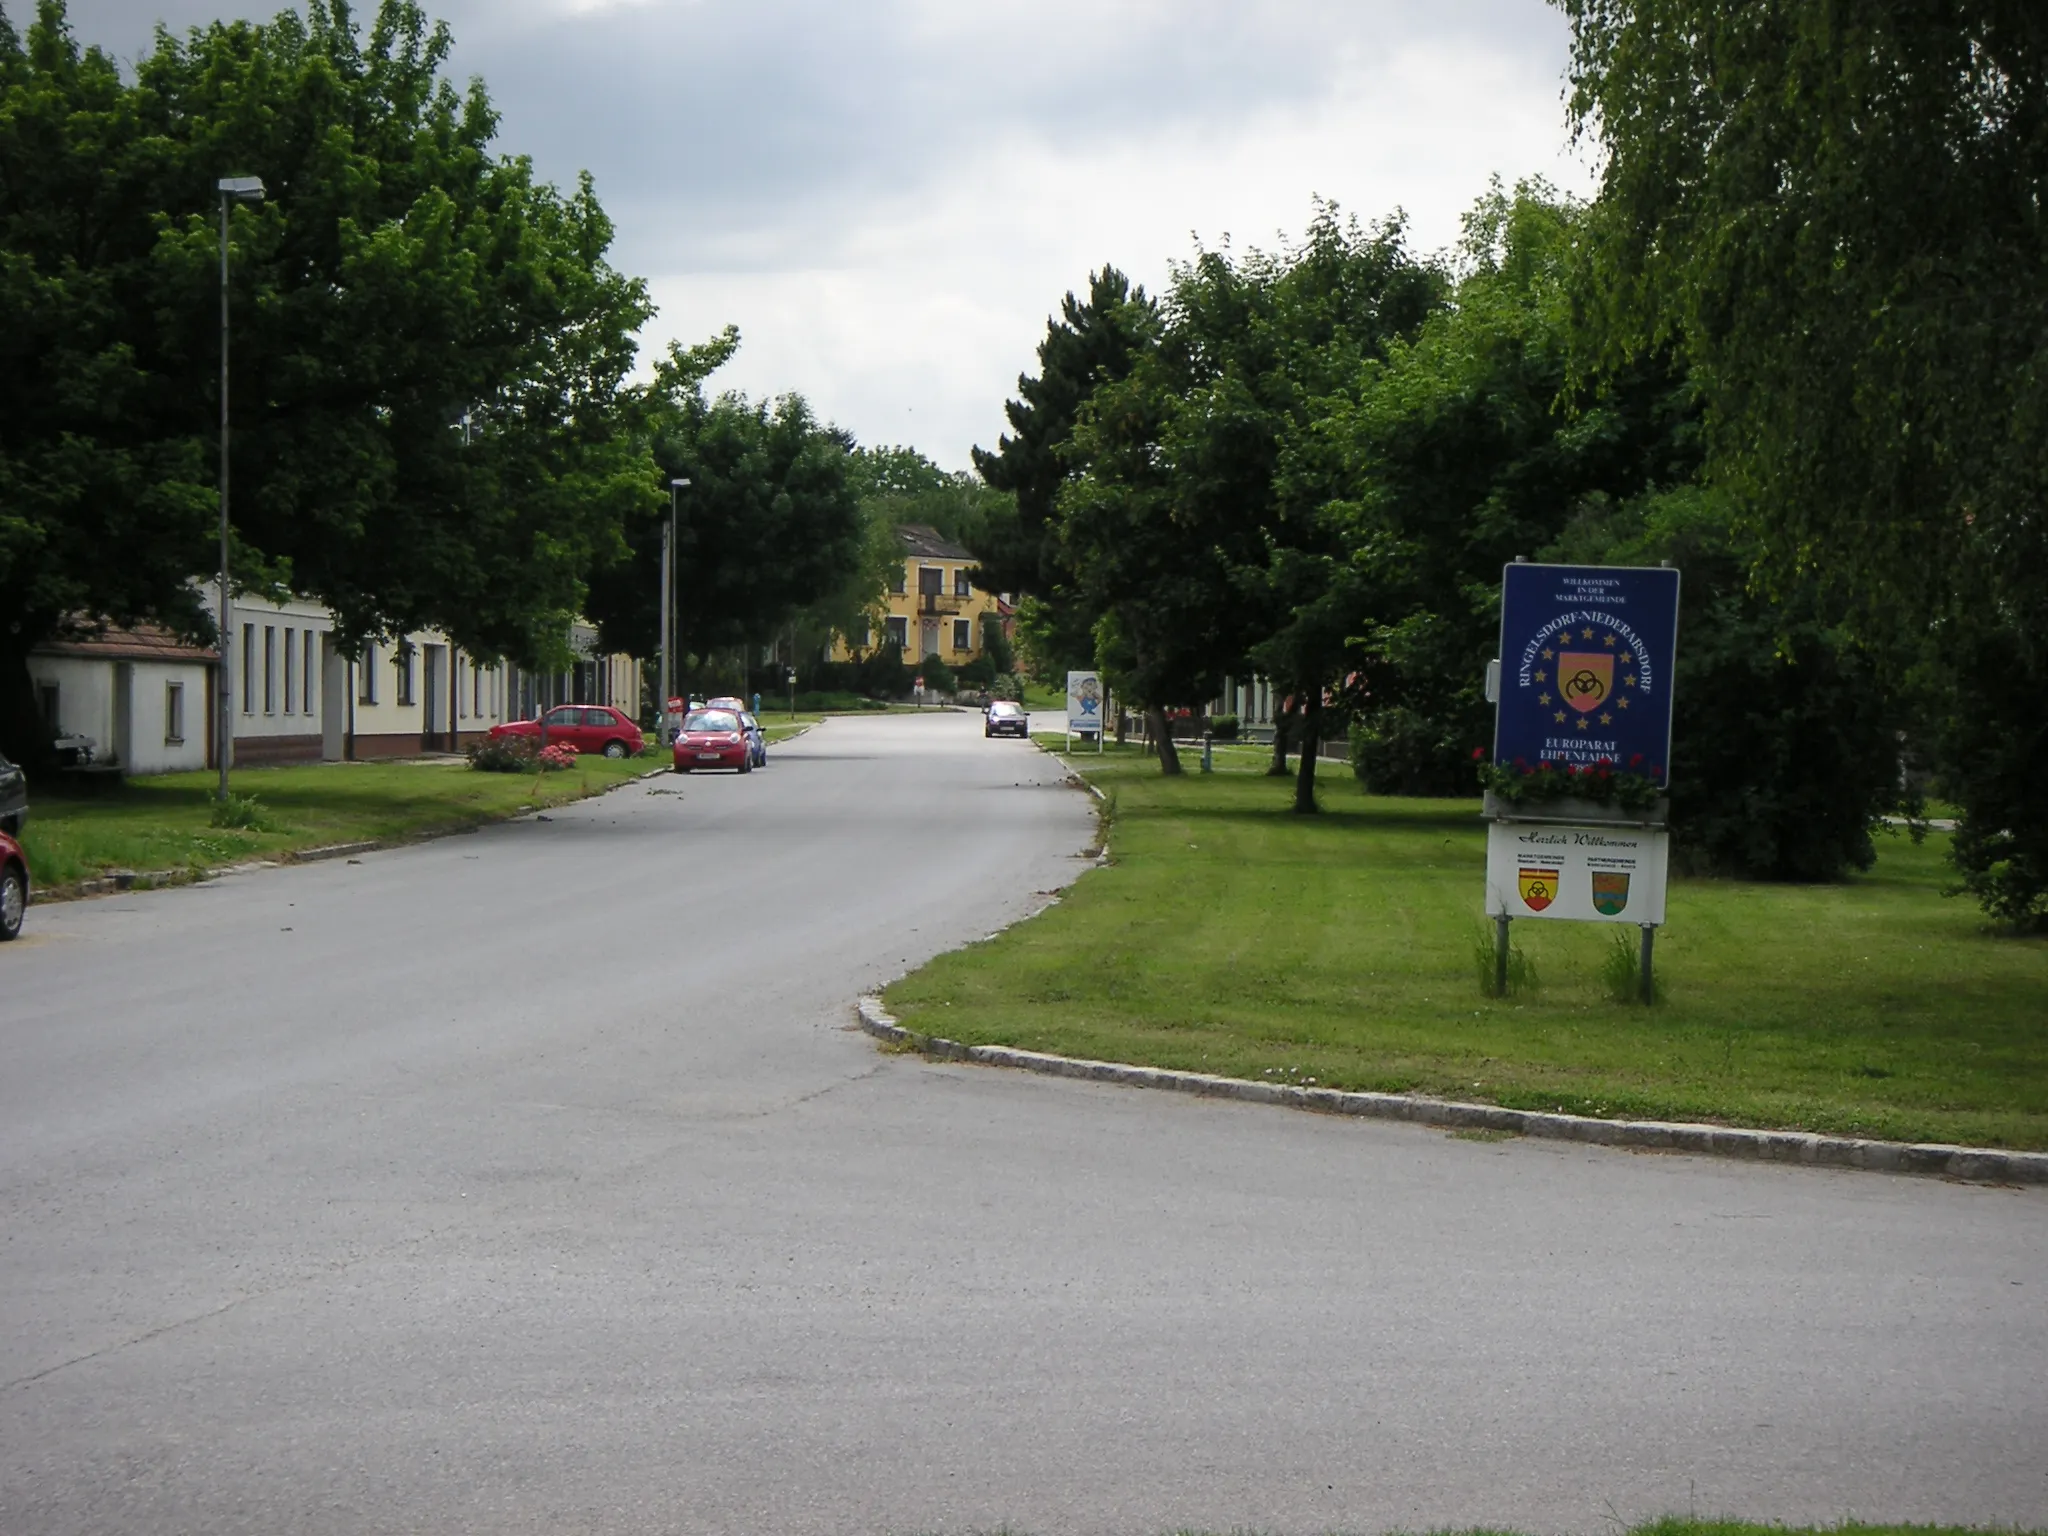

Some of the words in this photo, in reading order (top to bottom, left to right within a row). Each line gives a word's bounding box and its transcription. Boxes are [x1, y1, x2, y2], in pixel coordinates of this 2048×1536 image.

[1519, 610, 1653, 694] RINGELSDORF-NIEDERABSDORF
[1546, 738, 1617, 751] EUROPARAT
[1518, 831, 1568, 844] Herzlich
[1574, 833, 1638, 848] Willkommen
